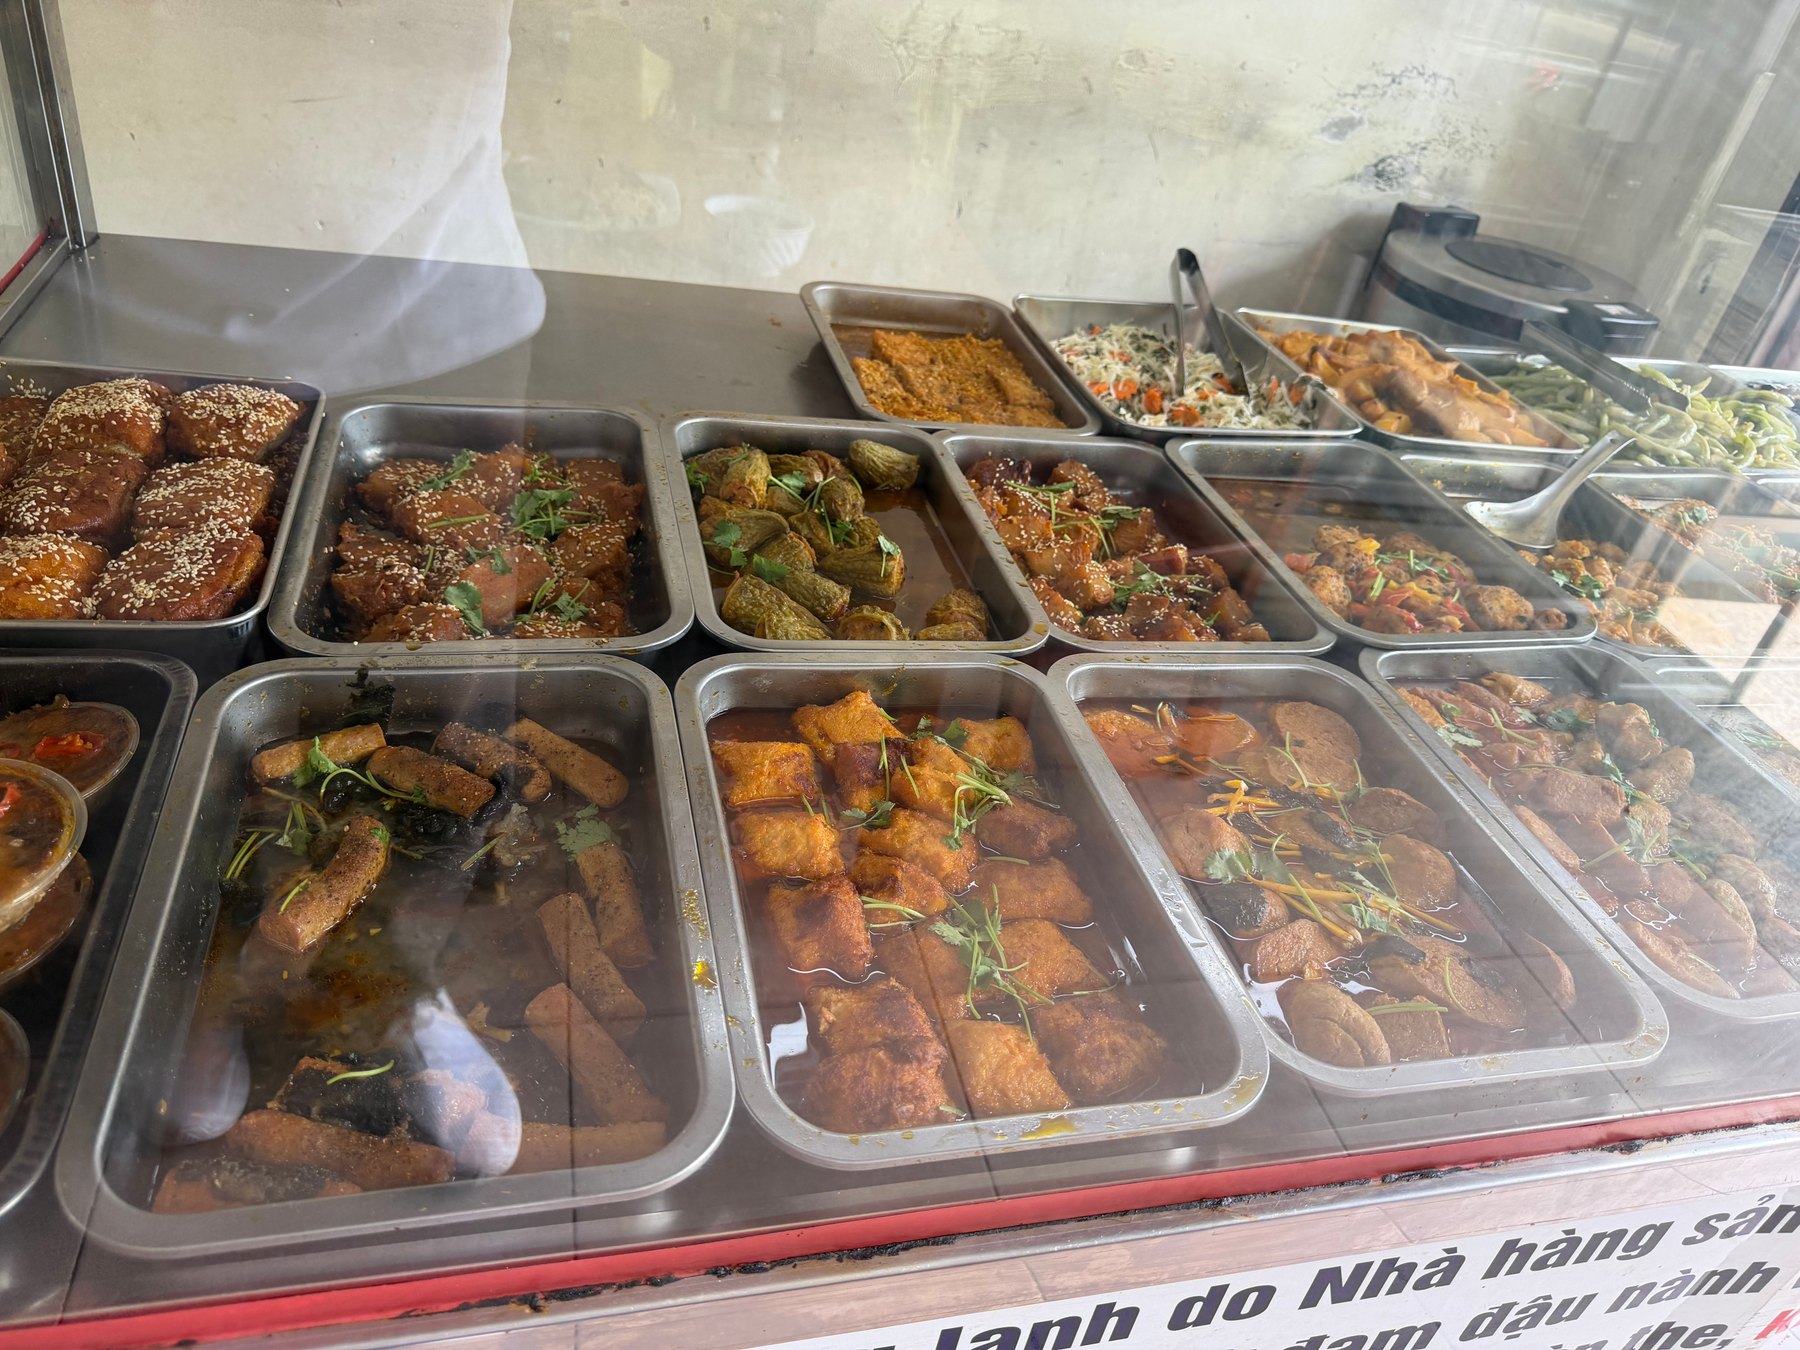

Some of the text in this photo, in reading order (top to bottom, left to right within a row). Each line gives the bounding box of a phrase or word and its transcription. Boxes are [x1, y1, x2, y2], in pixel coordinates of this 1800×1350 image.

[1167, 1283, 1277, 1331] do
[1298, 1246, 1466, 1310] Nhà
[1480, 1220, 1675, 1280] hàng
[1681, 1194, 1800, 1246] sản
[1458, 1294, 1599, 1342] đậu
[1603, 1261, 1780, 1314] nành
